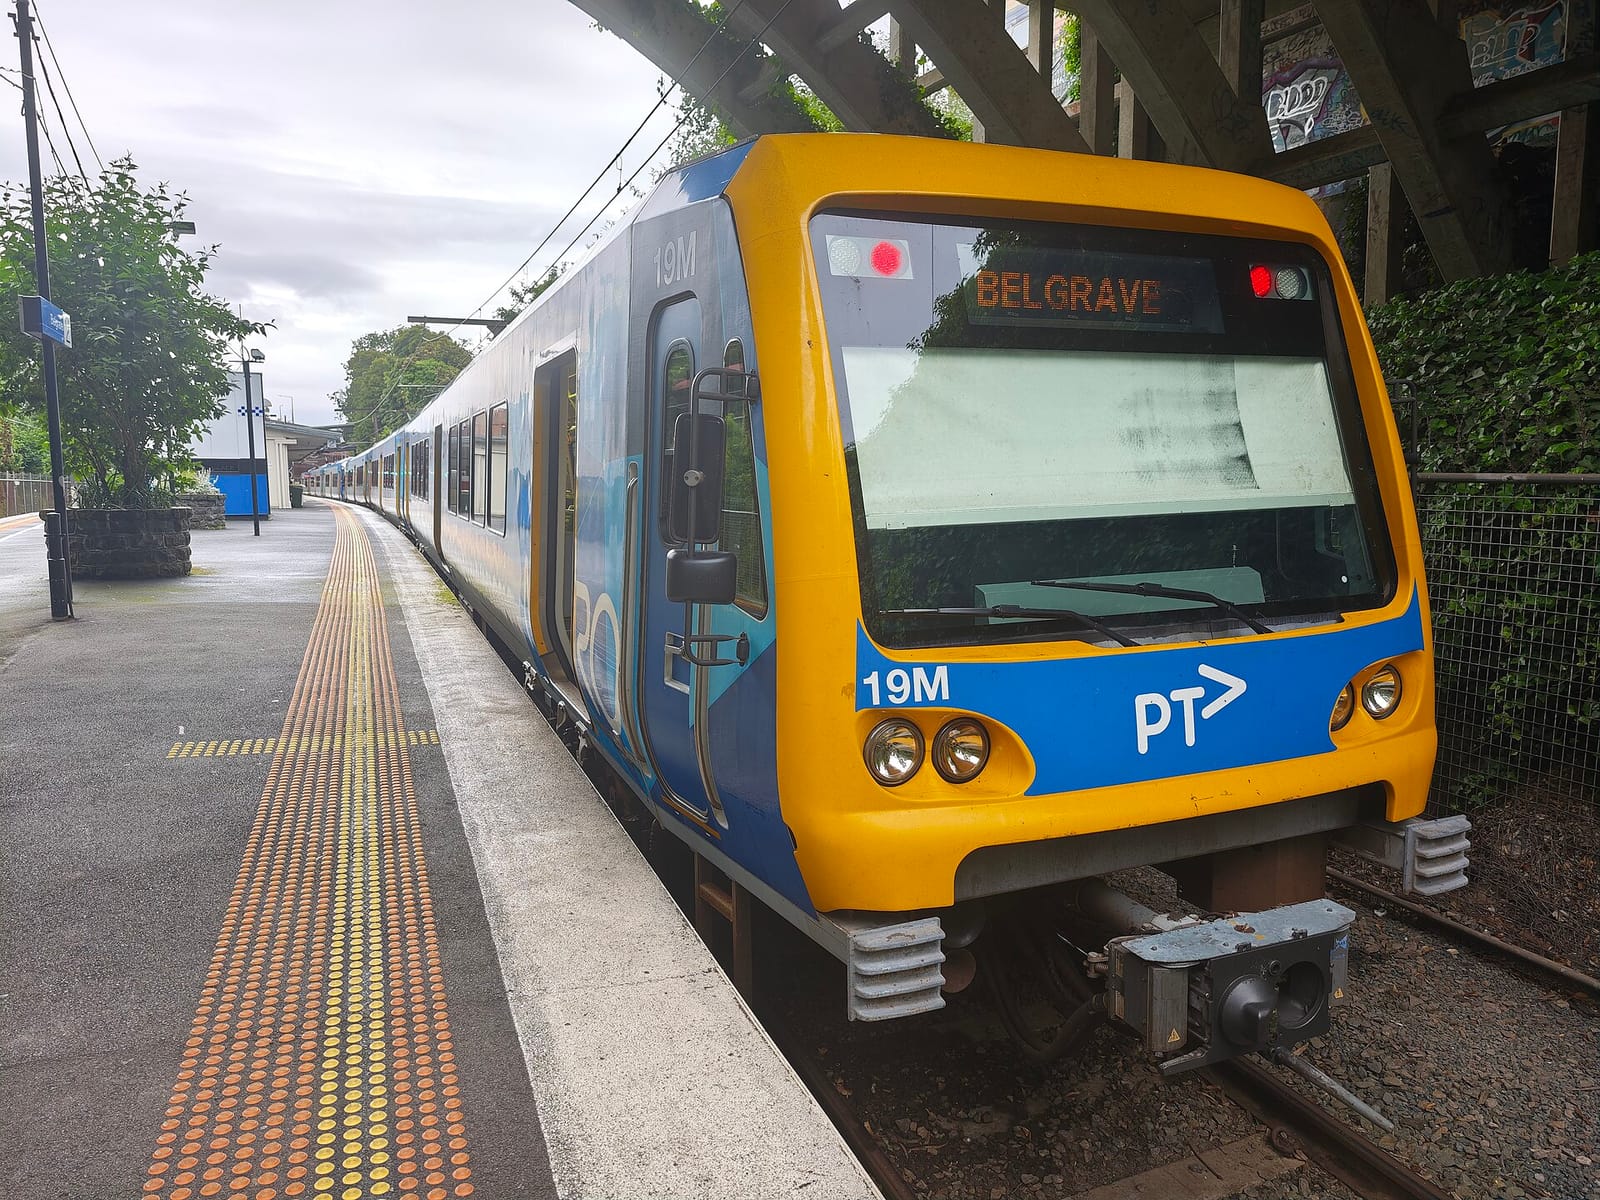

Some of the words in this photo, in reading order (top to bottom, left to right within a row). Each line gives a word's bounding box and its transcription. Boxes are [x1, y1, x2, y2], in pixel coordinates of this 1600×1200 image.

[653, 230, 697, 289] 19M
[976, 270, 1162, 314] BELGRAVE
[862, 664, 950, 706] 19M
